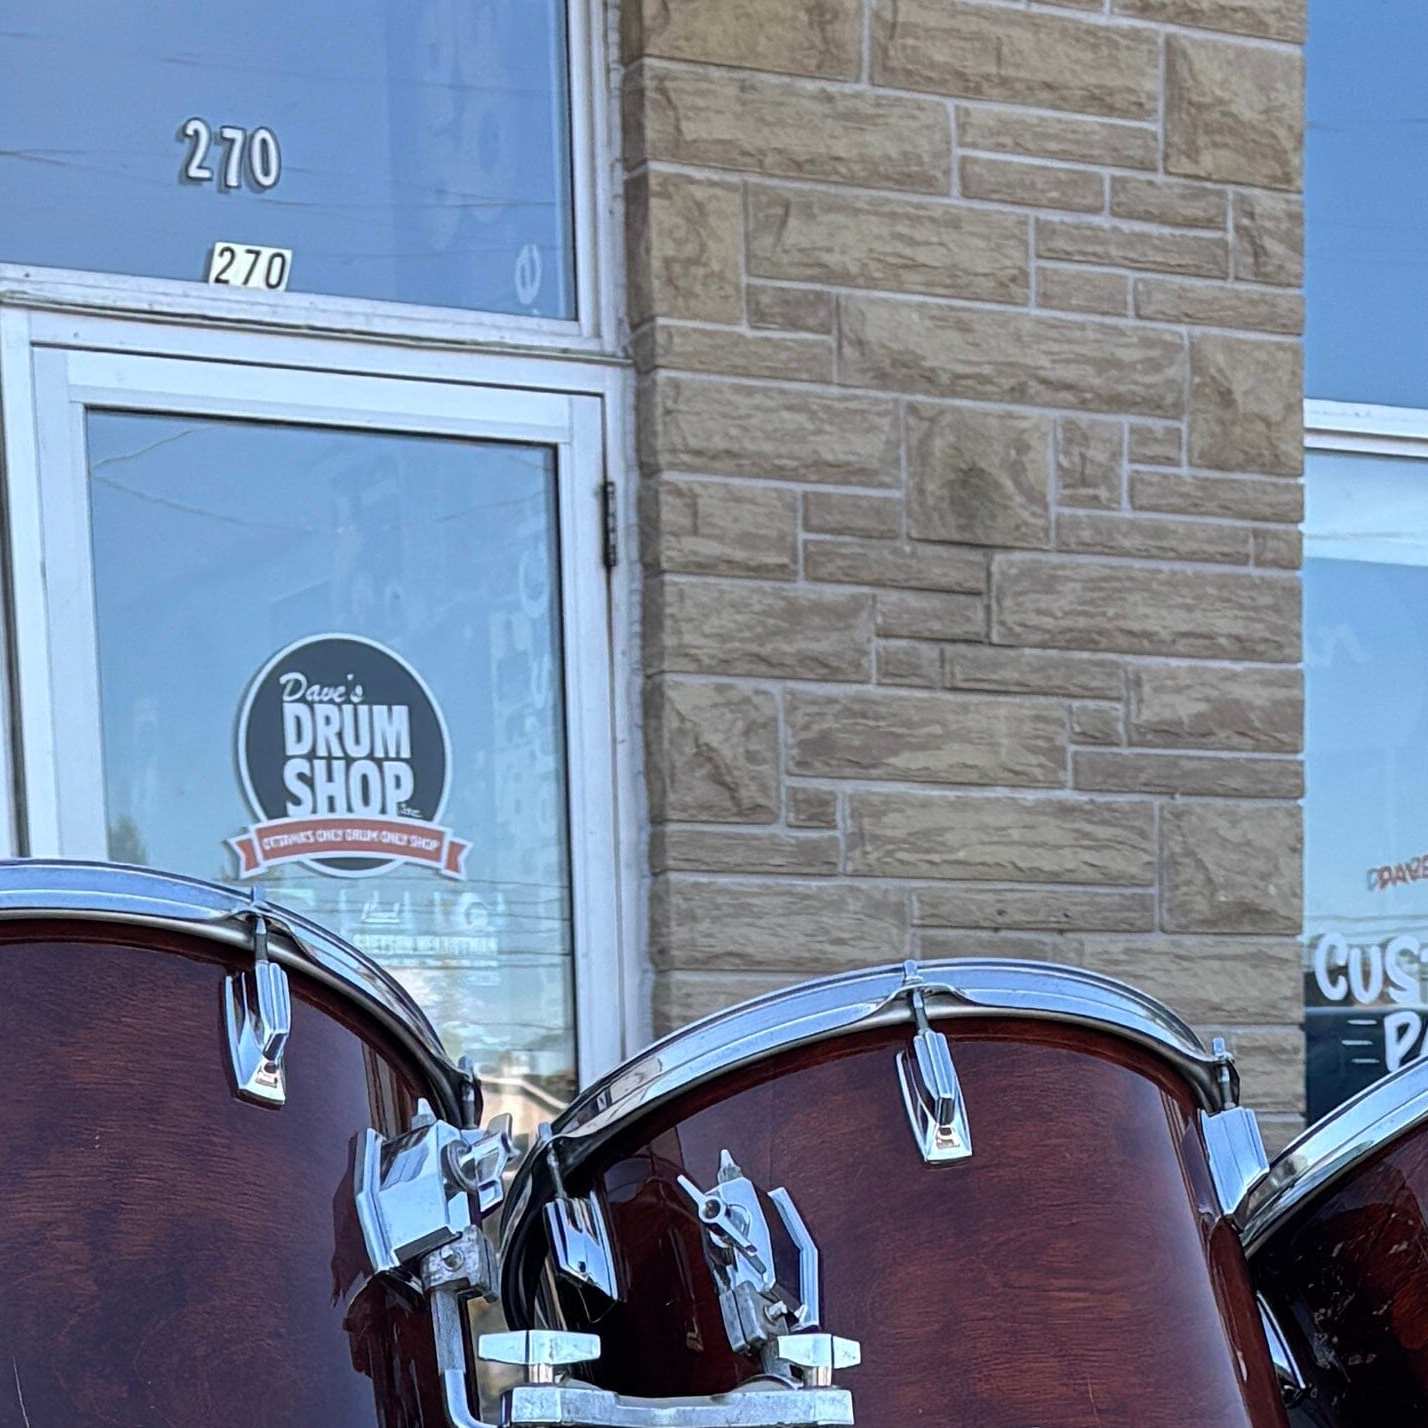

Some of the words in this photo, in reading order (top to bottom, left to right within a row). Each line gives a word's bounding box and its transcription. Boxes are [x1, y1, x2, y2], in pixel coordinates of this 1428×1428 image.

[182, 118, 281, 189] 270
[215, 246, 286, 290] 270
[280, 672, 364, 703] Dave's
[283, 703, 411, 757] DRUM
[283, 758, 414, 818] SHOP
